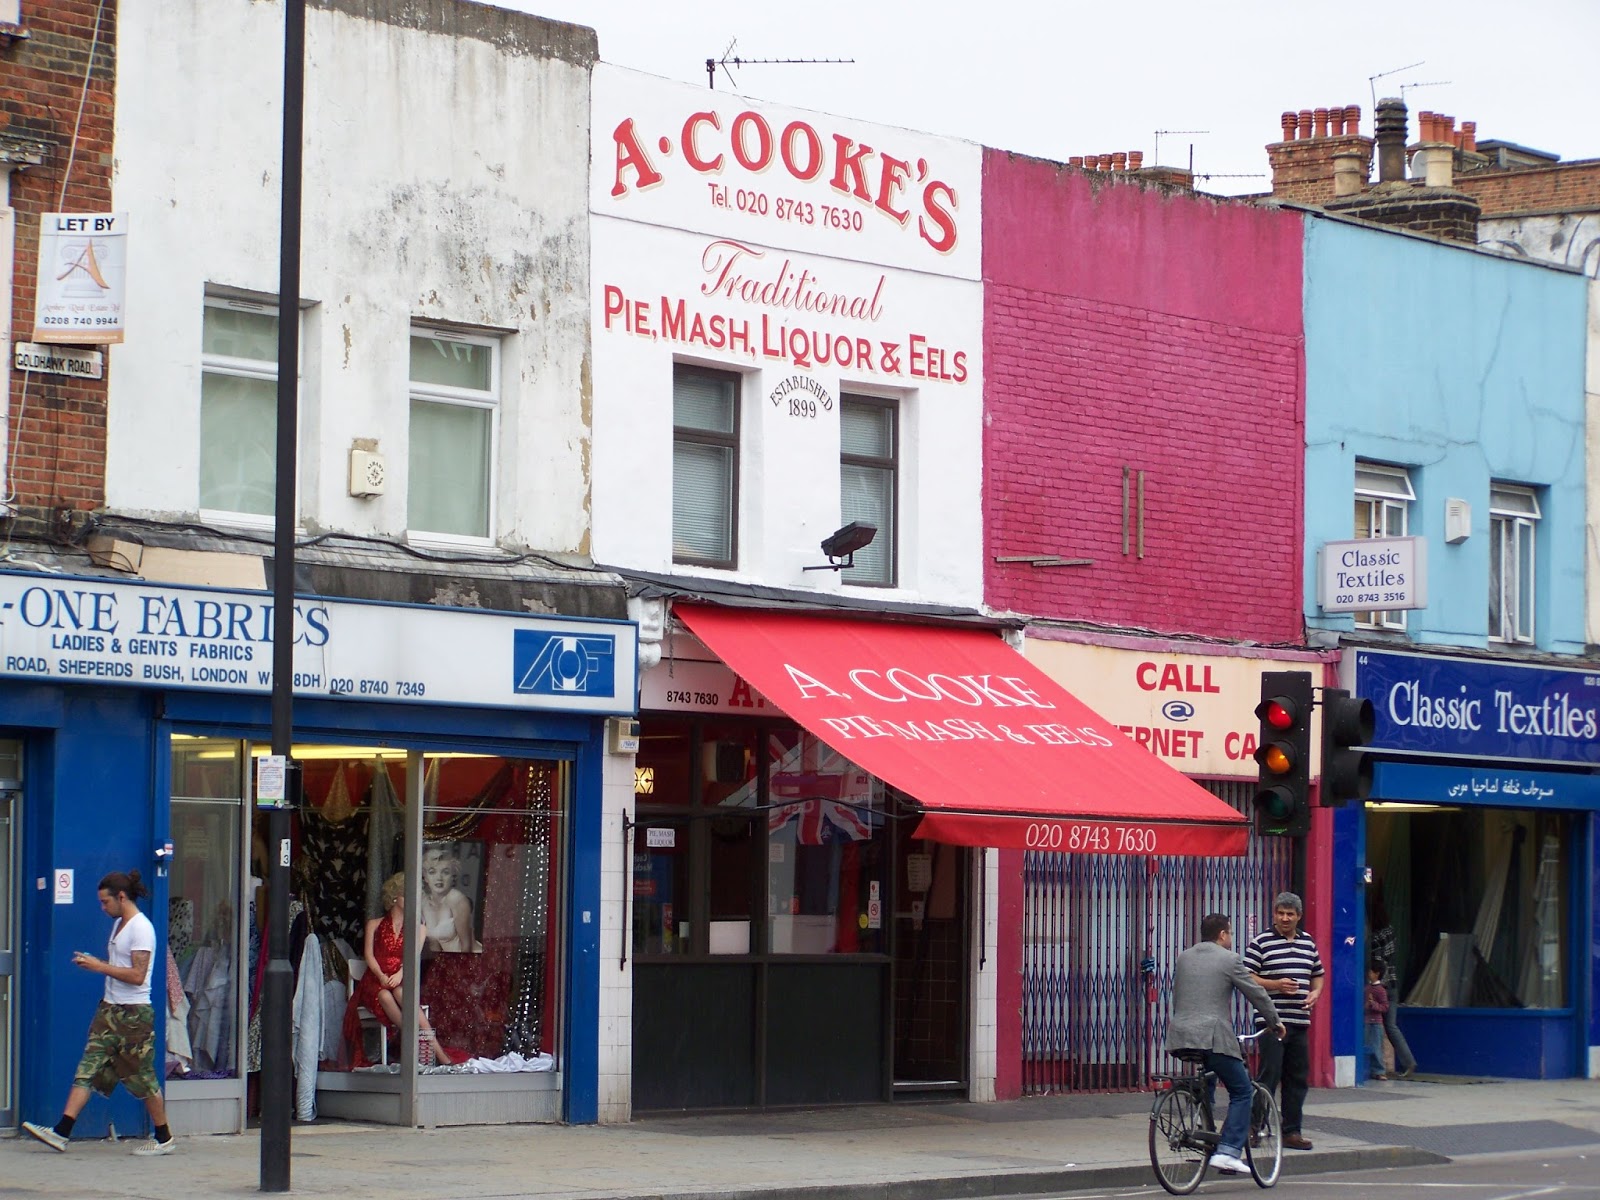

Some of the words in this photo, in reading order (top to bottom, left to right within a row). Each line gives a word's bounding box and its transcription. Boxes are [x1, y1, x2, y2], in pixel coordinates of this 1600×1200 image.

[708, 183, 731, 208] Tel.
[737, 189, 768, 215] 020
[776, 198, 814, 224] 8743
[821, 205, 863, 231] 7630
[57, 218, 88, 231] LET
[94, 217, 114, 231] BY
[701, 240, 885, 321] Traditional
[44, 316, 69, 325] 0208
[74, 317, 92, 325] 740
[96, 317, 118, 325] 9944
[763, 314, 873, 368] LIQUOR
[880, 341, 901, 375] &
[909, 334, 968, 382] EELS
[769, 375, 833, 411] ESTABLISHED
[788, 398, 816, 418] 1899
[1341, 549, 1400, 567] Classic
[1337, 570, 1405, 589] Textiles
[1336, 594, 1353, 604] 020
[1357, 593, 1379, 603] 8743
[1383, 592, 1405, 602] 3516
[52, 634, 105, 652] LADIES
[111, 638, 122, 653] &
[129, 639, 177, 656] GENTS
[190, 643, 253, 661] FABRICS
[1358, 656, 1368, 665] 44
[7, 656, 50, 674] ROAD,
[59, 659, 133, 677] SHEPERDS
[143, 664, 184, 682] BUSH,
[192, 667, 248, 684] LONDON
[294, 673, 320, 687] 8DH
[330, 678, 354, 693] 020
[359, 680, 388, 695] 8740
[396, 682, 425, 696] 7349
[849, 668, 1056, 709] COOKE
[1136, 662, 1220, 693] CALL
[667, 691, 691, 703] 8743
[694, 692, 718, 705] 7630
[1389, 680, 1481, 731] Classic
[1495, 690, 1597, 739] Textiles
[820, 716, 892, 739] PIE
[882, 718, 1004, 742] MASH
[997, 724, 1035, 744] &
[1025, 823, 1062, 847] 020
[1069, 825, 1109, 850] 8743
[1115, 827, 1156, 851] 7630
